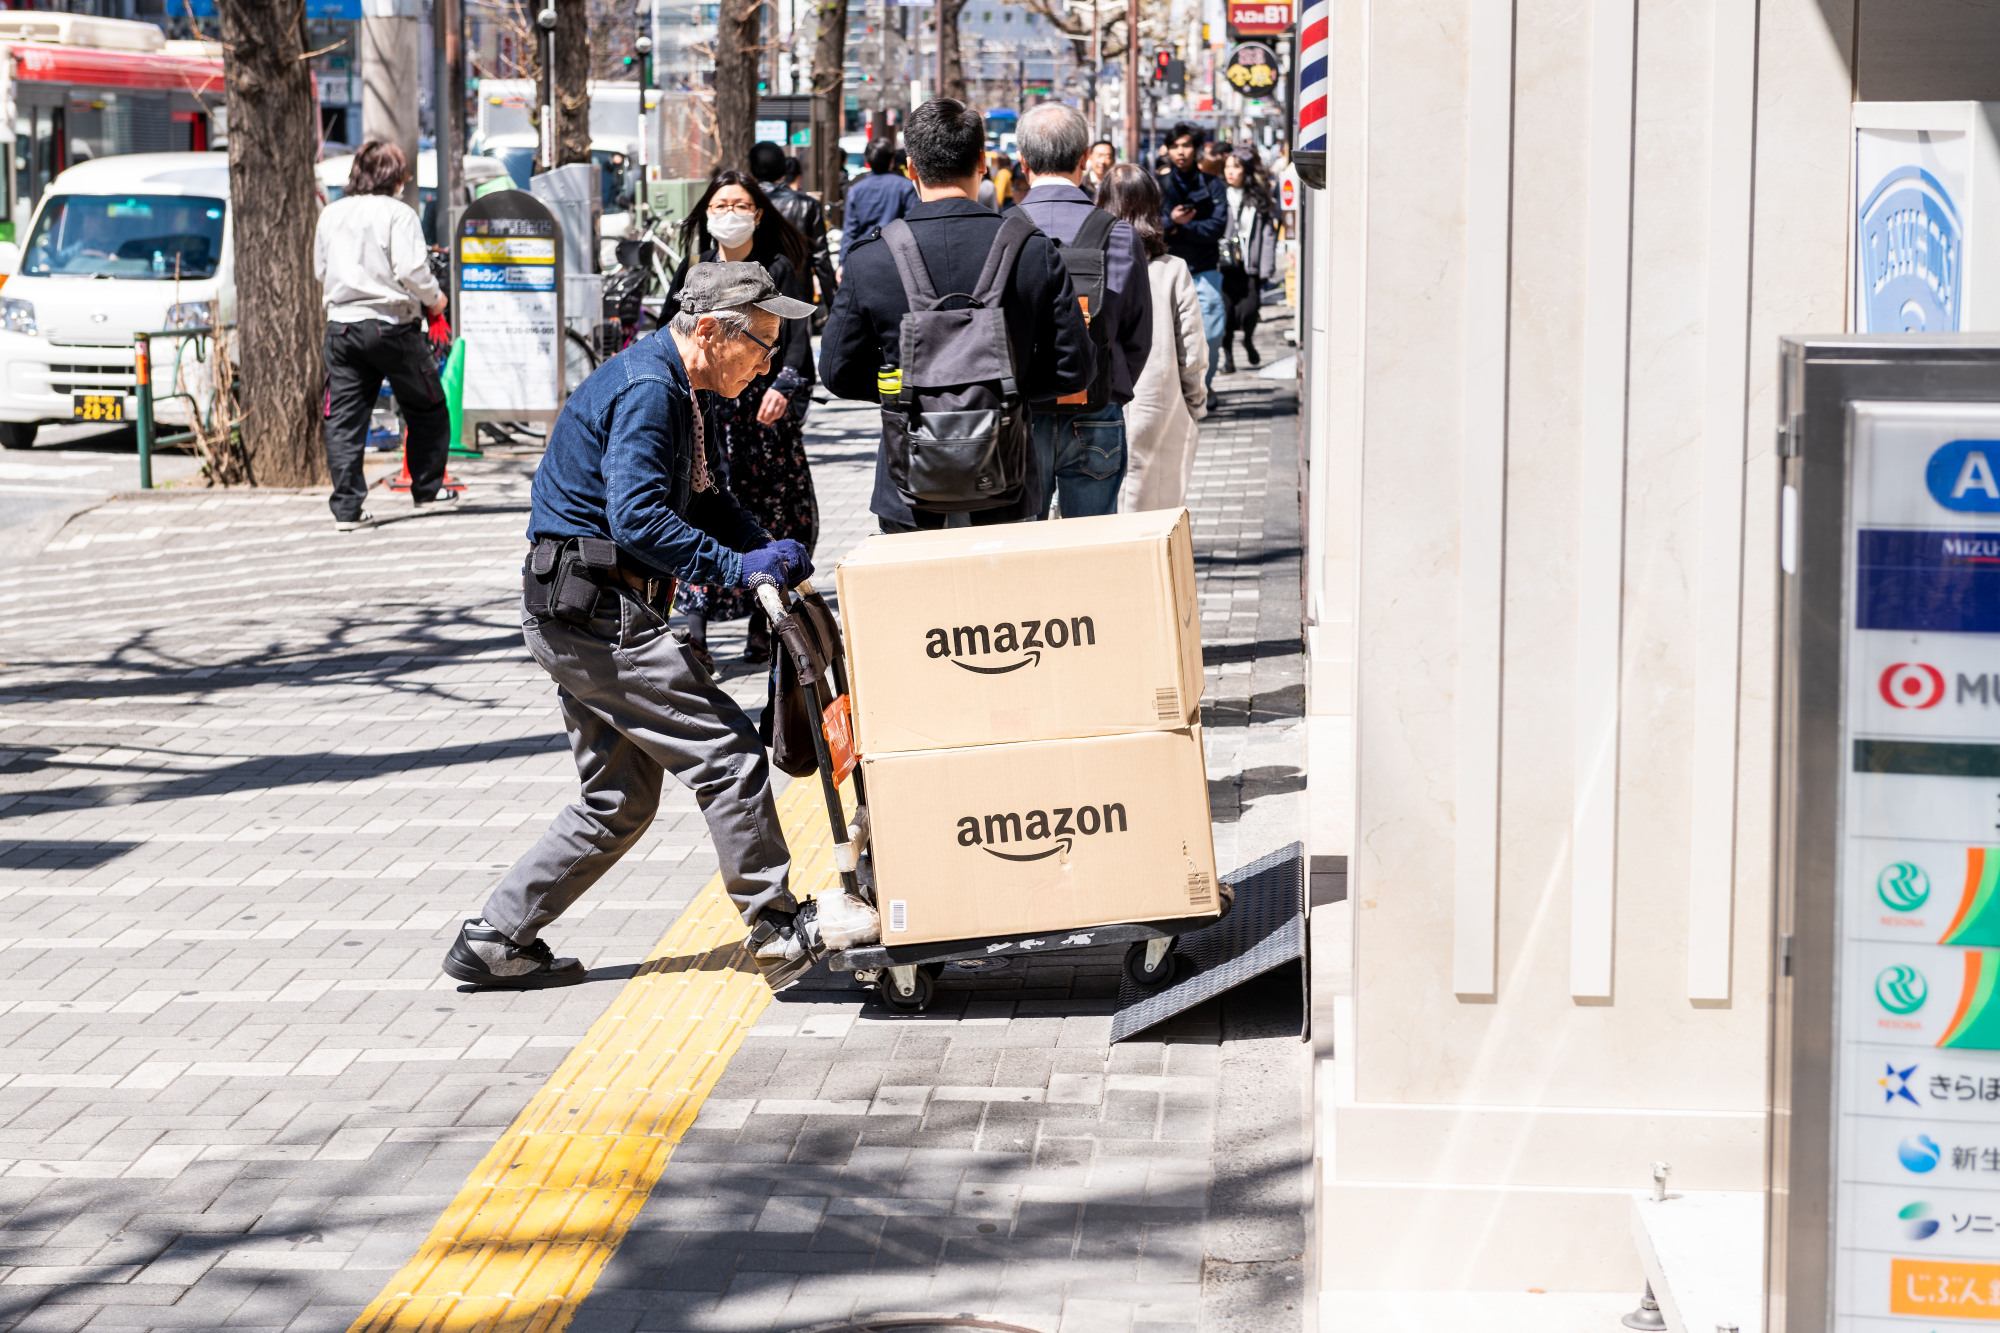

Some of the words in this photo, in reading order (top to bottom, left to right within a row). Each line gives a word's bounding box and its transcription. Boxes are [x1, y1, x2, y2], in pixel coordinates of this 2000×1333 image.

[1950, 451, 2000, 499] A
[925, 614, 1096, 658] amazon
[957, 802, 1128, 847] amazon
[1879, 915, 1926, 928] RESONA
[1877, 1018, 1923, 1031] RESONA
[1951, 1212, 2000, 1234] ソニ
